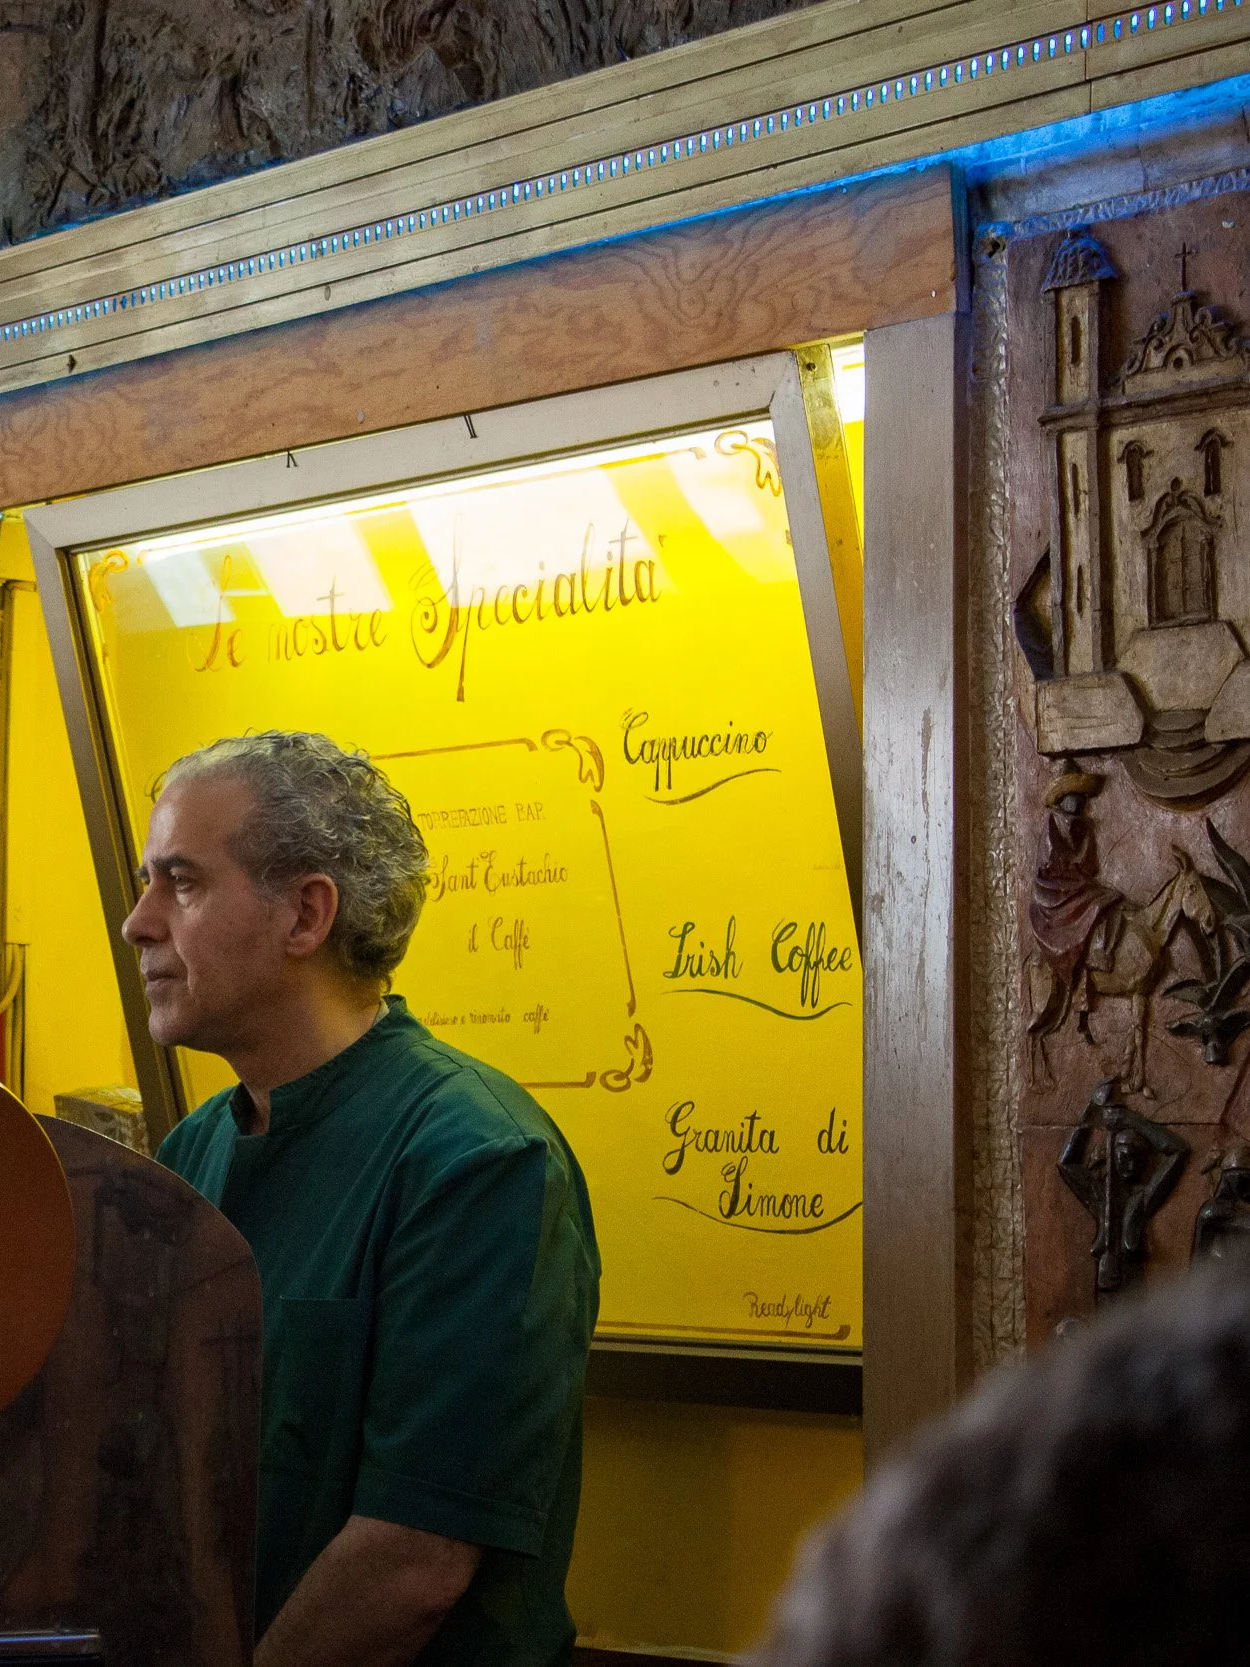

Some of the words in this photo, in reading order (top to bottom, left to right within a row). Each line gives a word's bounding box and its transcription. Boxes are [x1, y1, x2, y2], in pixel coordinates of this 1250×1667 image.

[186, 554, 247, 672] Le
[267, 575, 387, 664] nostre
[620, 707, 773, 792] Cappuccino
[468, 924, 479, 953] il
[663, 915, 743, 979] Irish
[771, 917, 853, 1008] Coffee
[662, 1101, 779, 1175] Granita
[817, 1107, 849, 1154] di
